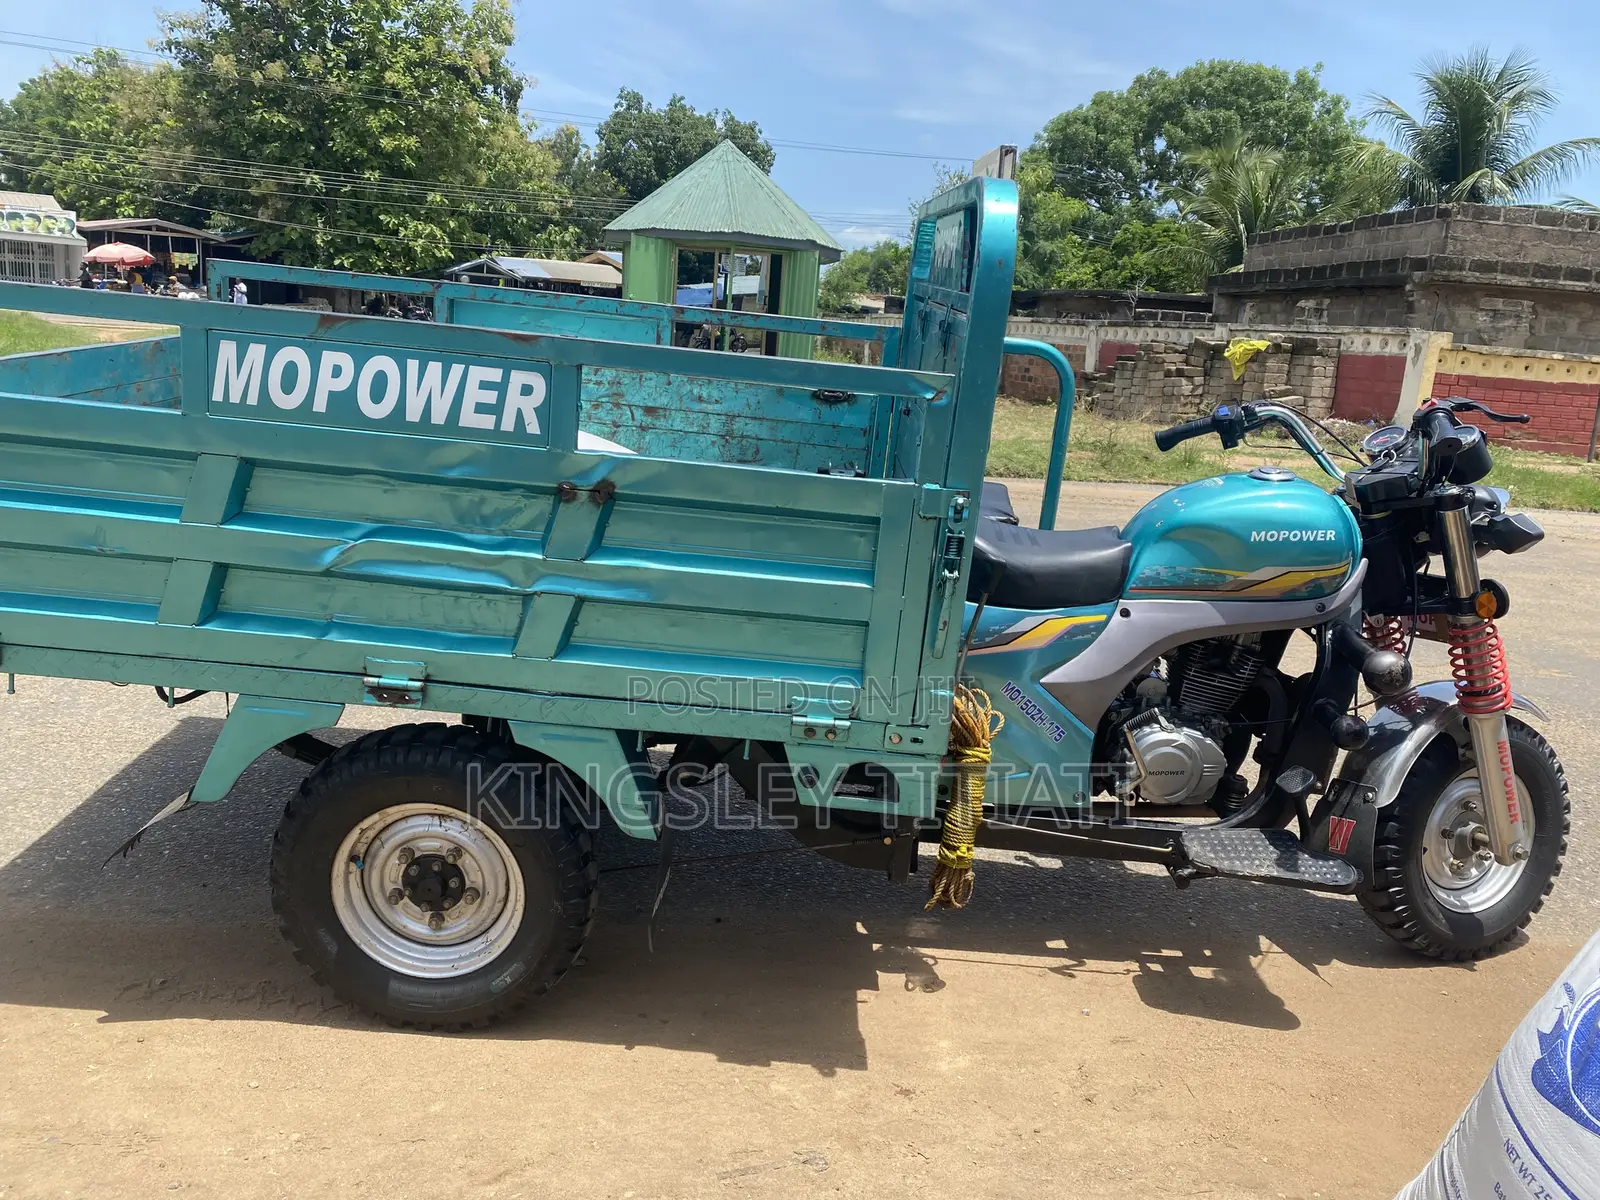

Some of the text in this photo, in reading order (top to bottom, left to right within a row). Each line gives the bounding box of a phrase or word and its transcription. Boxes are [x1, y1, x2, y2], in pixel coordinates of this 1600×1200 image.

[211, 340, 546, 434] MOPOWER
[1250, 529, 1336, 542] MOPOWER
[1497, 740, 1519, 824] MOPOWER
[1503, 1138, 1521, 1164] NET
[1519, 1161, 1537, 1187] WT
